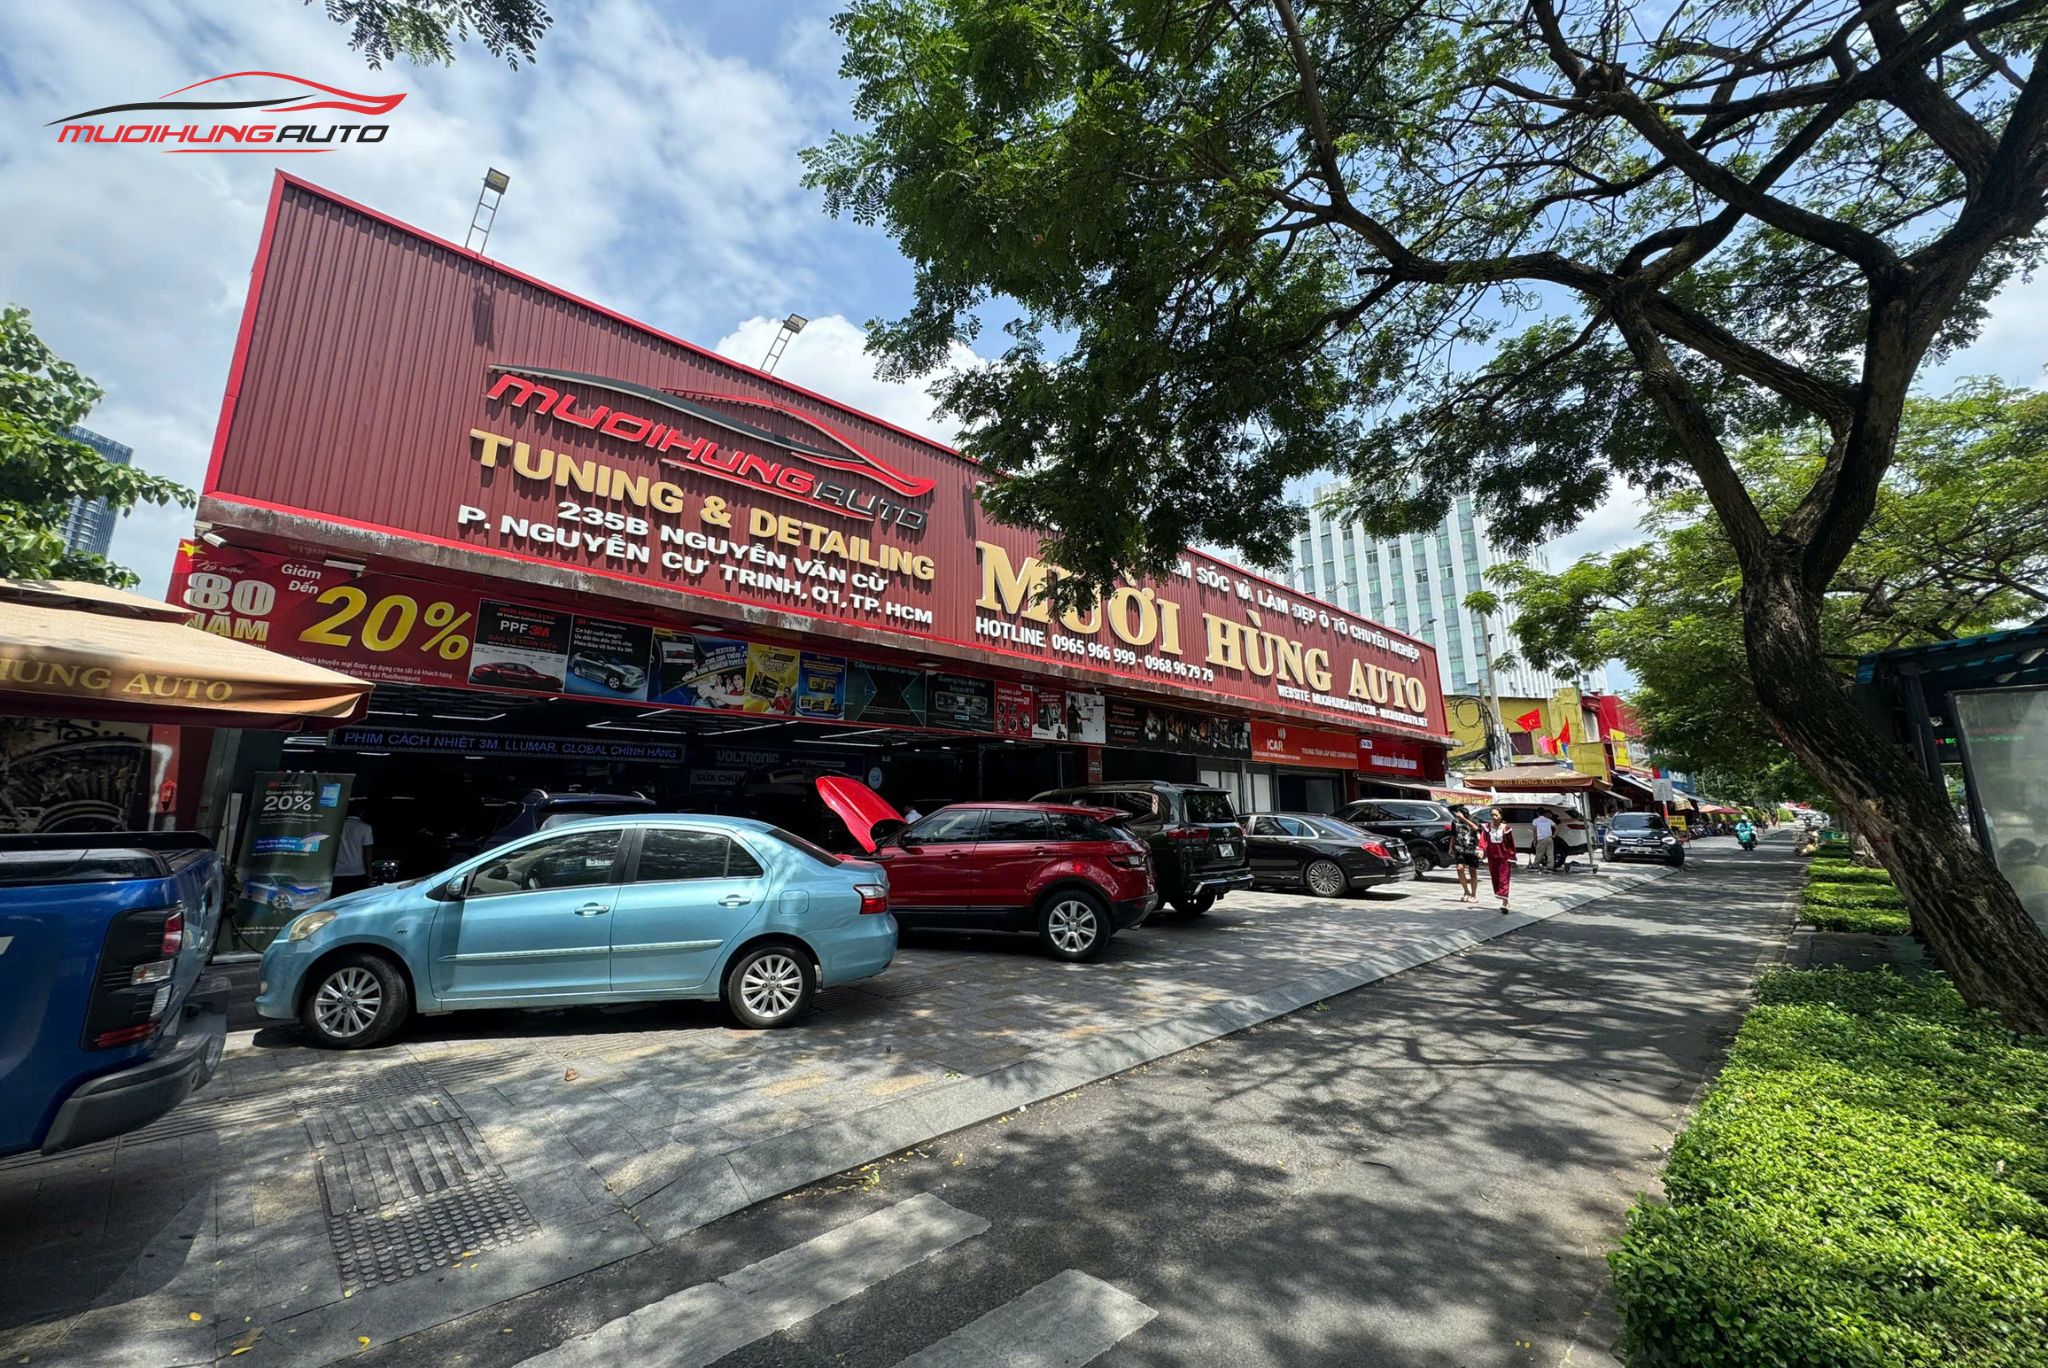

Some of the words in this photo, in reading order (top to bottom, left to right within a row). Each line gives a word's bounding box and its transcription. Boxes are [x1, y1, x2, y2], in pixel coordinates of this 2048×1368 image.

[470, 428, 685, 514] TUNING
[700, 495, 732, 529] &
[749, 507, 935, 580] DETAILING
[458, 504, 491, 530] P.
[500, 515, 650, 563] NGUYỄN
[885, 601, 933, 624] HCM
[557, 501, 649, 536] 235B
[660, 525, 786, 570] NGUYỄN
[793, 558, 846, 583] VĂN
[852, 572, 889, 592] CỪ
[281, 563, 322, 580] Giảm
[288, 580, 319, 595] Đến
[183, 572, 276, 616] 80
[1196, 566, 1230, 592] SÓC
[1234, 578, 1254, 602] VÀ
[1257, 588, 1289, 614] LÀM
[1318, 610, 1330, 628] Ô
[1331, 616, 1348, 635] TÔ
[299, 586, 471, 661] 20%
[500, 620, 529, 634] PPF
[529, 625, 550, 637] 3M
[1051, 634, 1085, 655] 0965
[1088, 642, 1111, 660] 966
[1113, 648, 1136, 666] 999
[1144, 655, 1172, 673] 0968
[1173, 660, 1187, 676] 96
[1202, 667, 1214, 682] 79
[1202, 609, 1332, 693] HÙNG
[1349, 658, 1427, 713] AUTO
[122, 673, 233, 702] AUTO
[344, 732, 383, 744] PHIM
[562, 743, 608, 756] GLOBAL
[1266, 739, 1284, 751] ICAR
[263, 795, 313, 811] 20%
